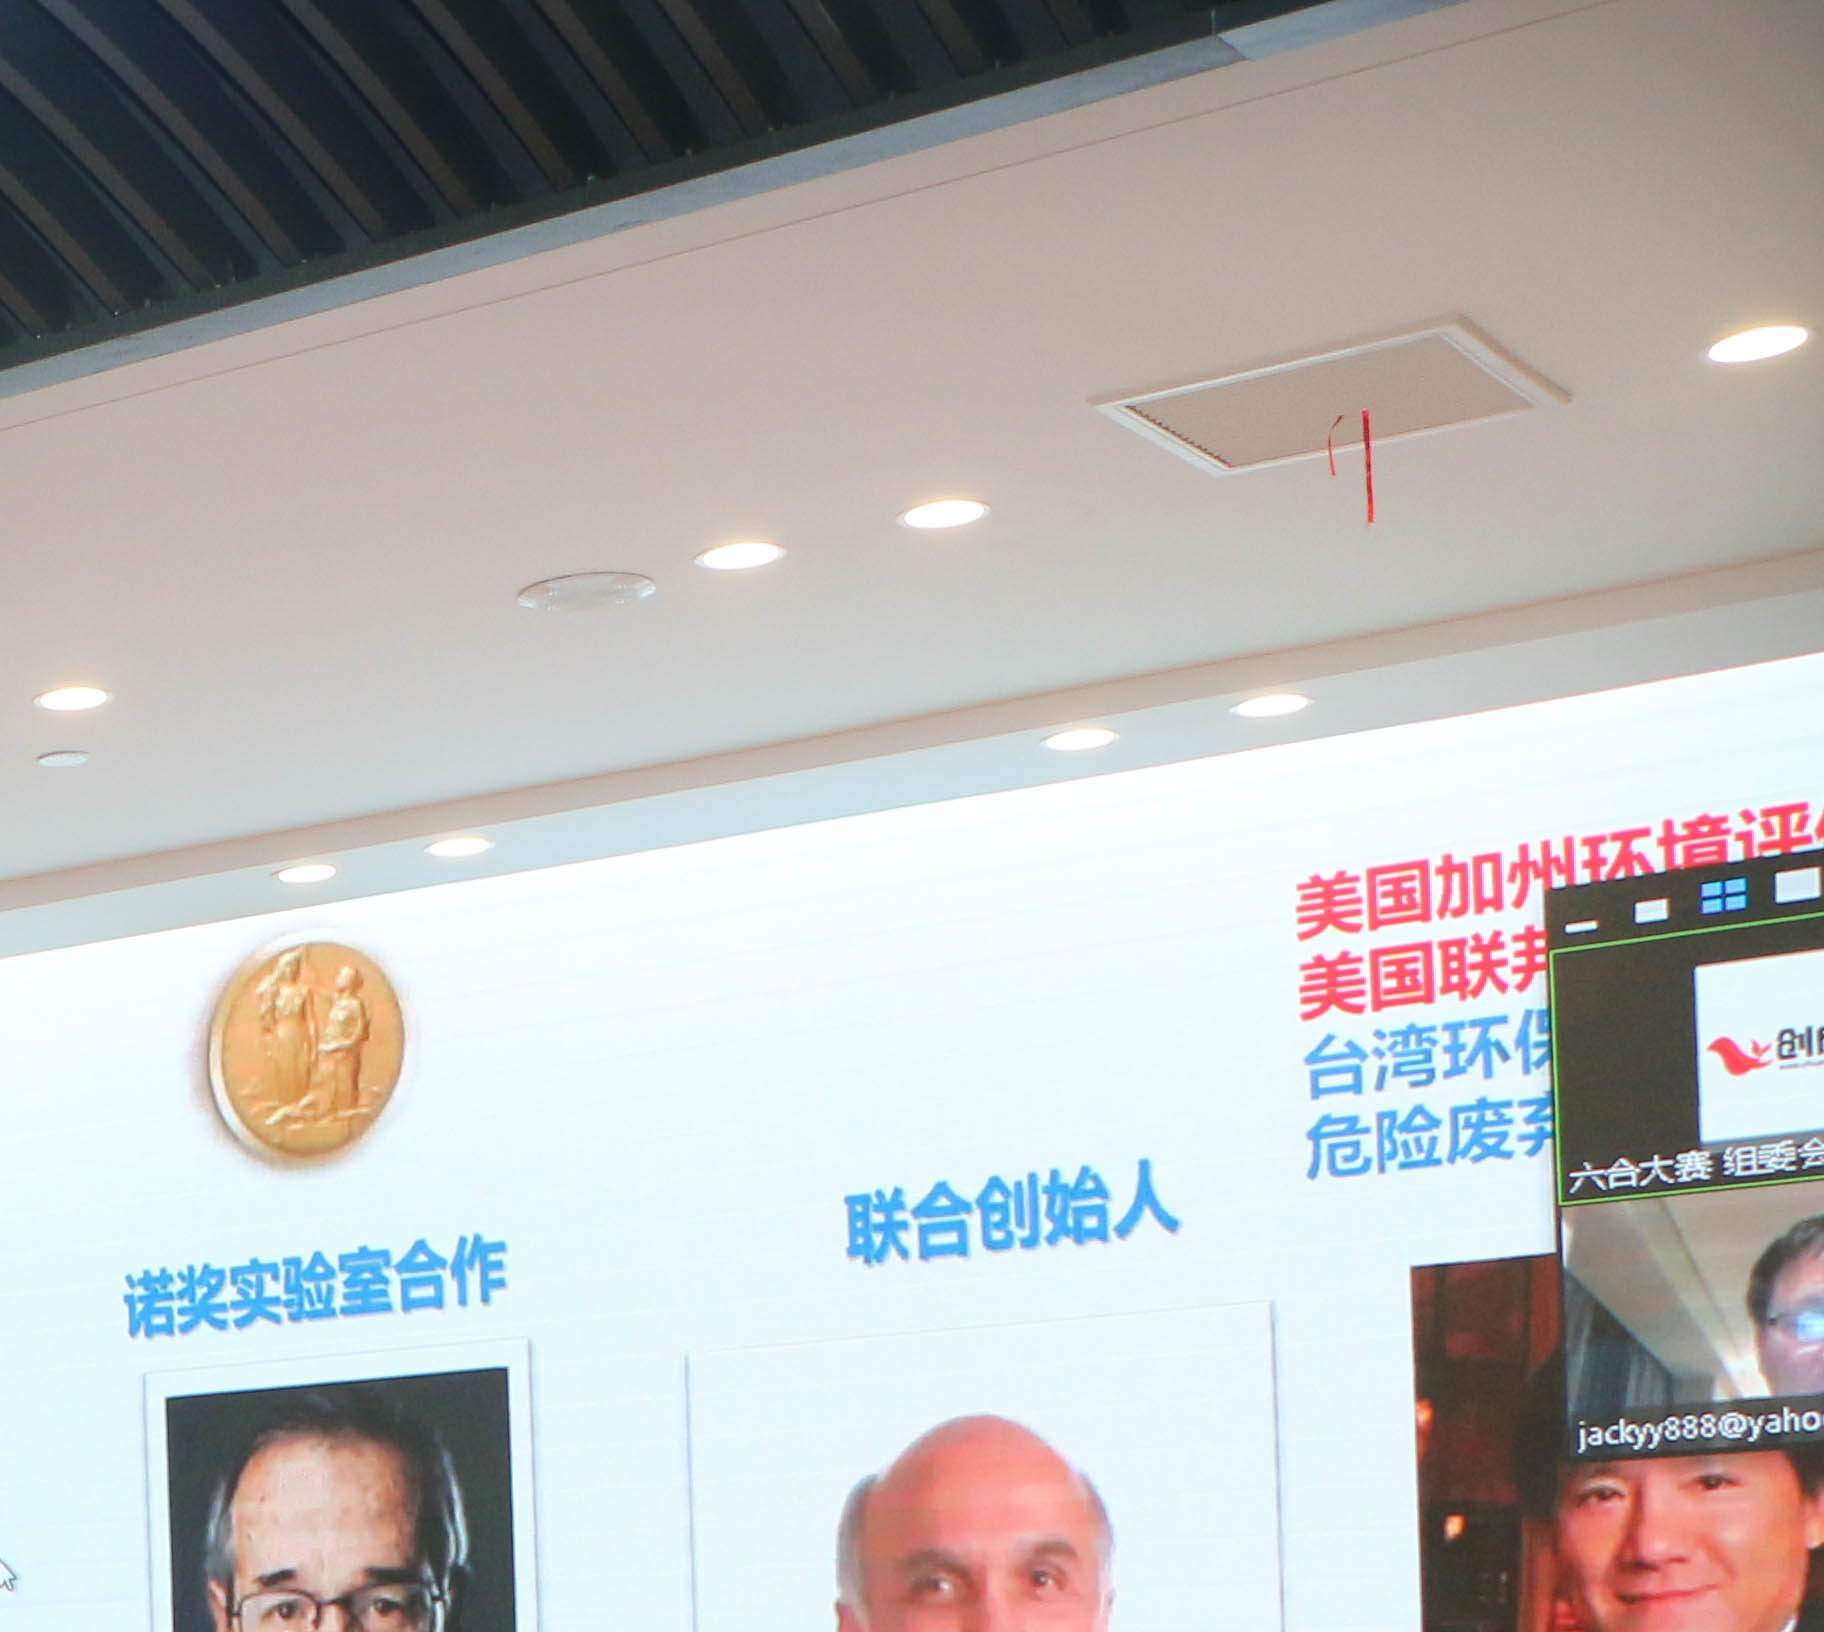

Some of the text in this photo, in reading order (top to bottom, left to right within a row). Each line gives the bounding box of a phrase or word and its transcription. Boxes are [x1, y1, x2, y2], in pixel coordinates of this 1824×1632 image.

[1296, 800, 1824, 941] 美国加州环境评
[843, 1157, 1181, 1267] 联合创始人
[1569, 1136, 1824, 1195] 六合大赛 组委会
[122, 1231, 508, 1340] 诺奖实验室合作
[1577, 1406, 1824, 1454] jackyy888@yaho
